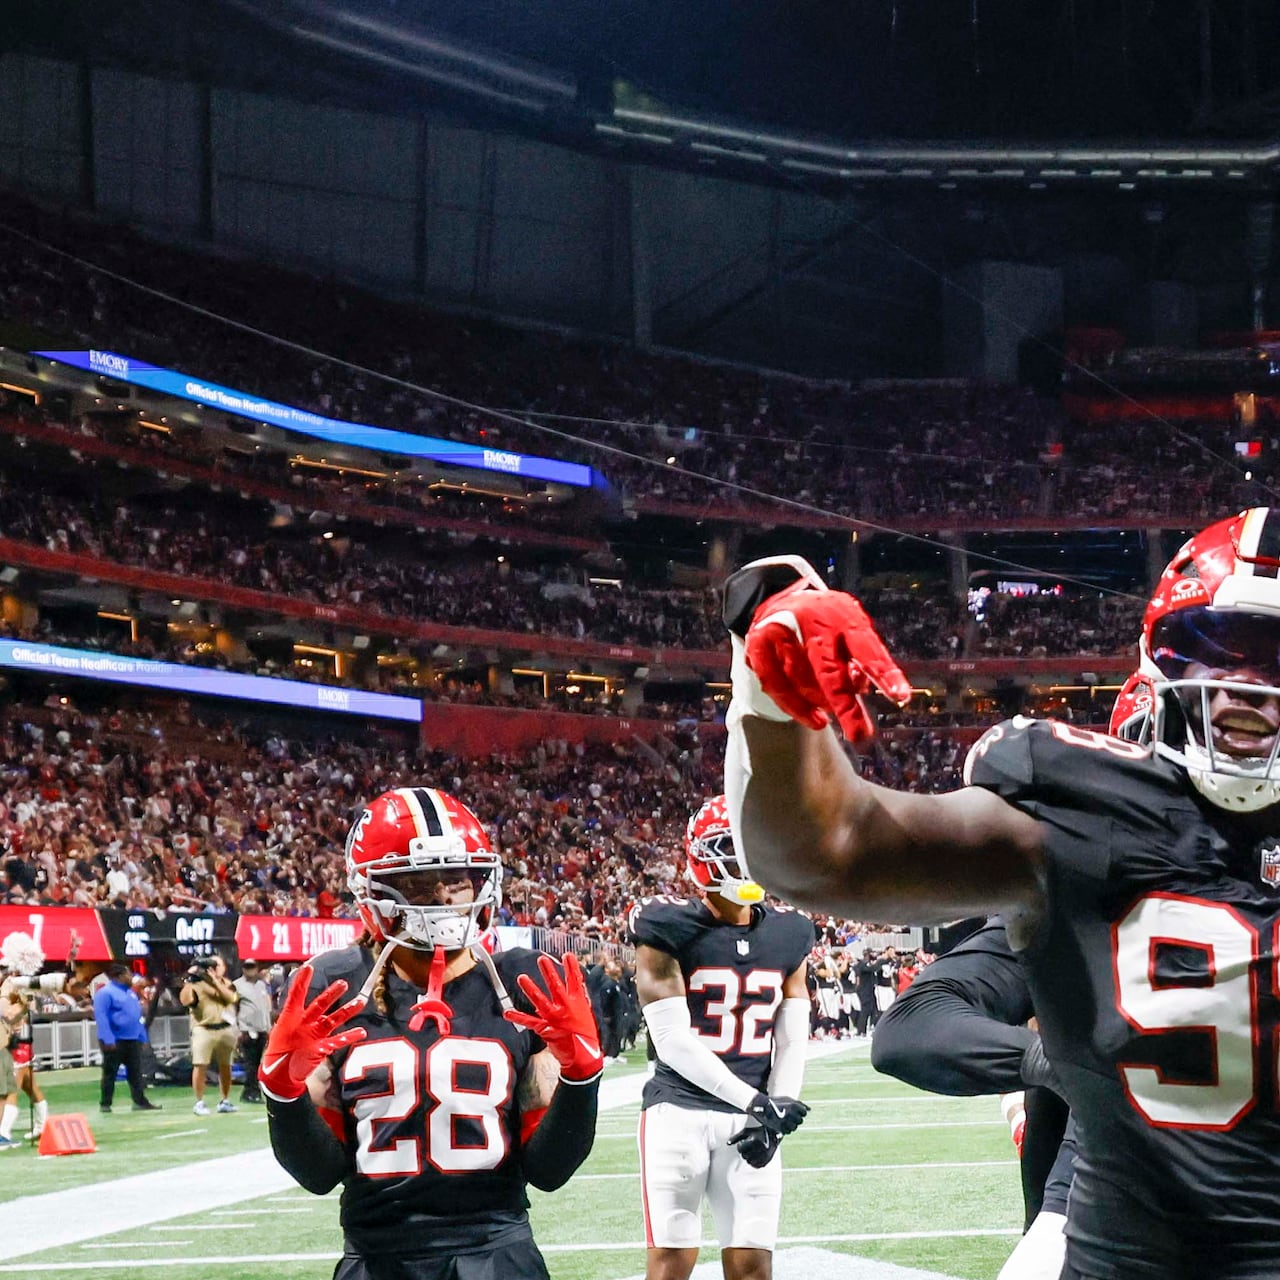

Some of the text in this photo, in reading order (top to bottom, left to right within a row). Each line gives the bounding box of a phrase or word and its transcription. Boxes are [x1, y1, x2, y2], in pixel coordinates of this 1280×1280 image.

[89, 349, 128, 373] EMORY
[185, 381, 217, 404] Official
[218, 391, 241, 409] Team
[242, 399, 289, 420] Healthcare
[484, 450, 521, 466] EMORY
[12, 647, 50, 665] Official
[51, 650, 79, 668] Team
[80, 654, 133, 673] Healthcare
[318, 687, 349, 703] EMORY
[28, 915, 44, 943] 7
[128, 915, 144, 929] QTR
[176, 917, 214, 940] 0:07
[125, 932, 151, 955] 2ND
[272, 922, 355, 955] 21 FALCONS
[689, 966, 784, 1056] 32
[343, 1036, 514, 1179] 28
[55, 1119, 89, 1149] 10
